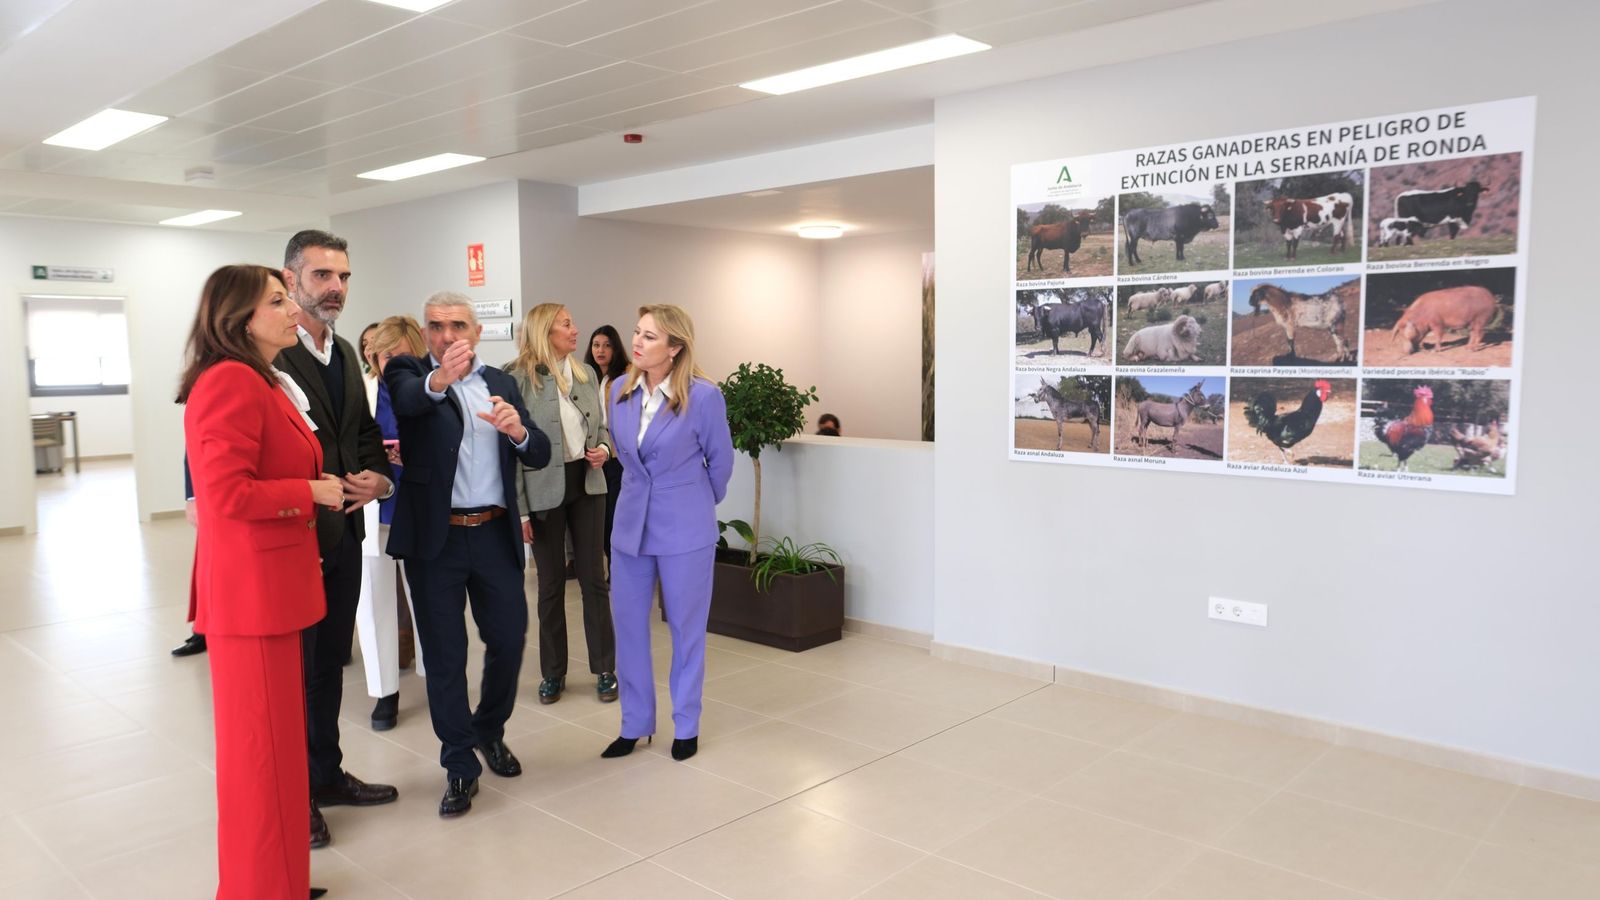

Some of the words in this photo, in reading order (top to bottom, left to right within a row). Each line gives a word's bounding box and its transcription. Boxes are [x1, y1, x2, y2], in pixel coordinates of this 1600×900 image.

[1136, 148, 1188, 168] RAZAS
[1192, 134, 1300, 160] GANADERAS
[1307, 128, 1332, 147] EN
[1339, 116, 1430, 142] PELIGRO
[1438, 111, 1467, 131] DE
[1121, 164, 1210, 190] EXTINCIÓN
[1215, 163, 1238, 180] EN
[1244, 160, 1266, 177] LA
[1270, 146, 1368, 174] SERRANÍA
[1374, 144, 1400, 162] DE
[1407, 134, 1487, 159] RONDA
[1274, 267, 1305, 275] Berrenda
[1317, 265, 1344, 273] Colorao
[1414, 260, 1450, 268] Berrenda
[1464, 259, 1490, 267] Negro
